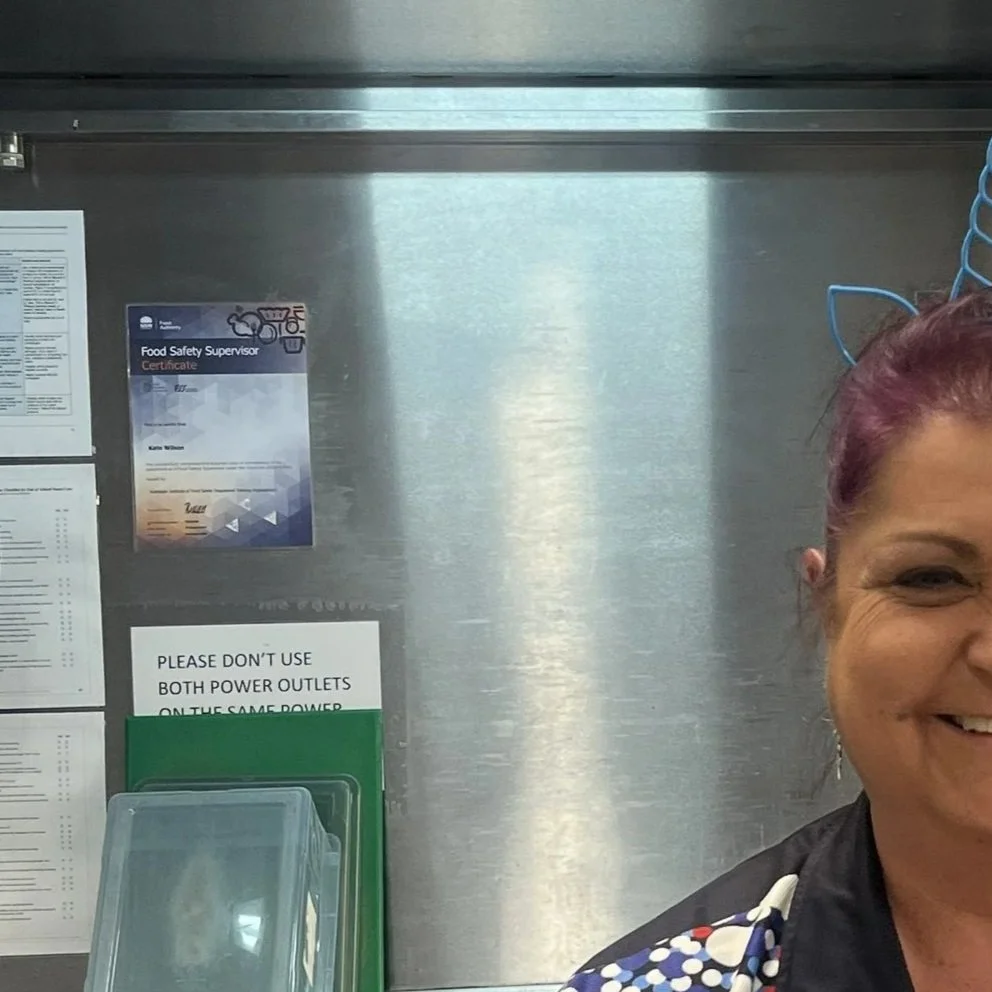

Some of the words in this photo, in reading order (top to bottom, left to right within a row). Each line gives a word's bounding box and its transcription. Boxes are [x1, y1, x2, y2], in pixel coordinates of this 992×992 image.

[141, 346, 167, 357] Food
[169, 346, 202, 358] Safety
[205, 345, 259, 358] Supervisor
[141, 360, 198, 371] Certificate
[157, 654, 217, 669] PLEASE
[222, 652, 276, 668] DON'T
[281, 652, 312, 666] USE
[158, 680, 205, 695] BOTH
[210, 678, 273, 694] POWER
[278, 676, 351, 692] OUTLETS
